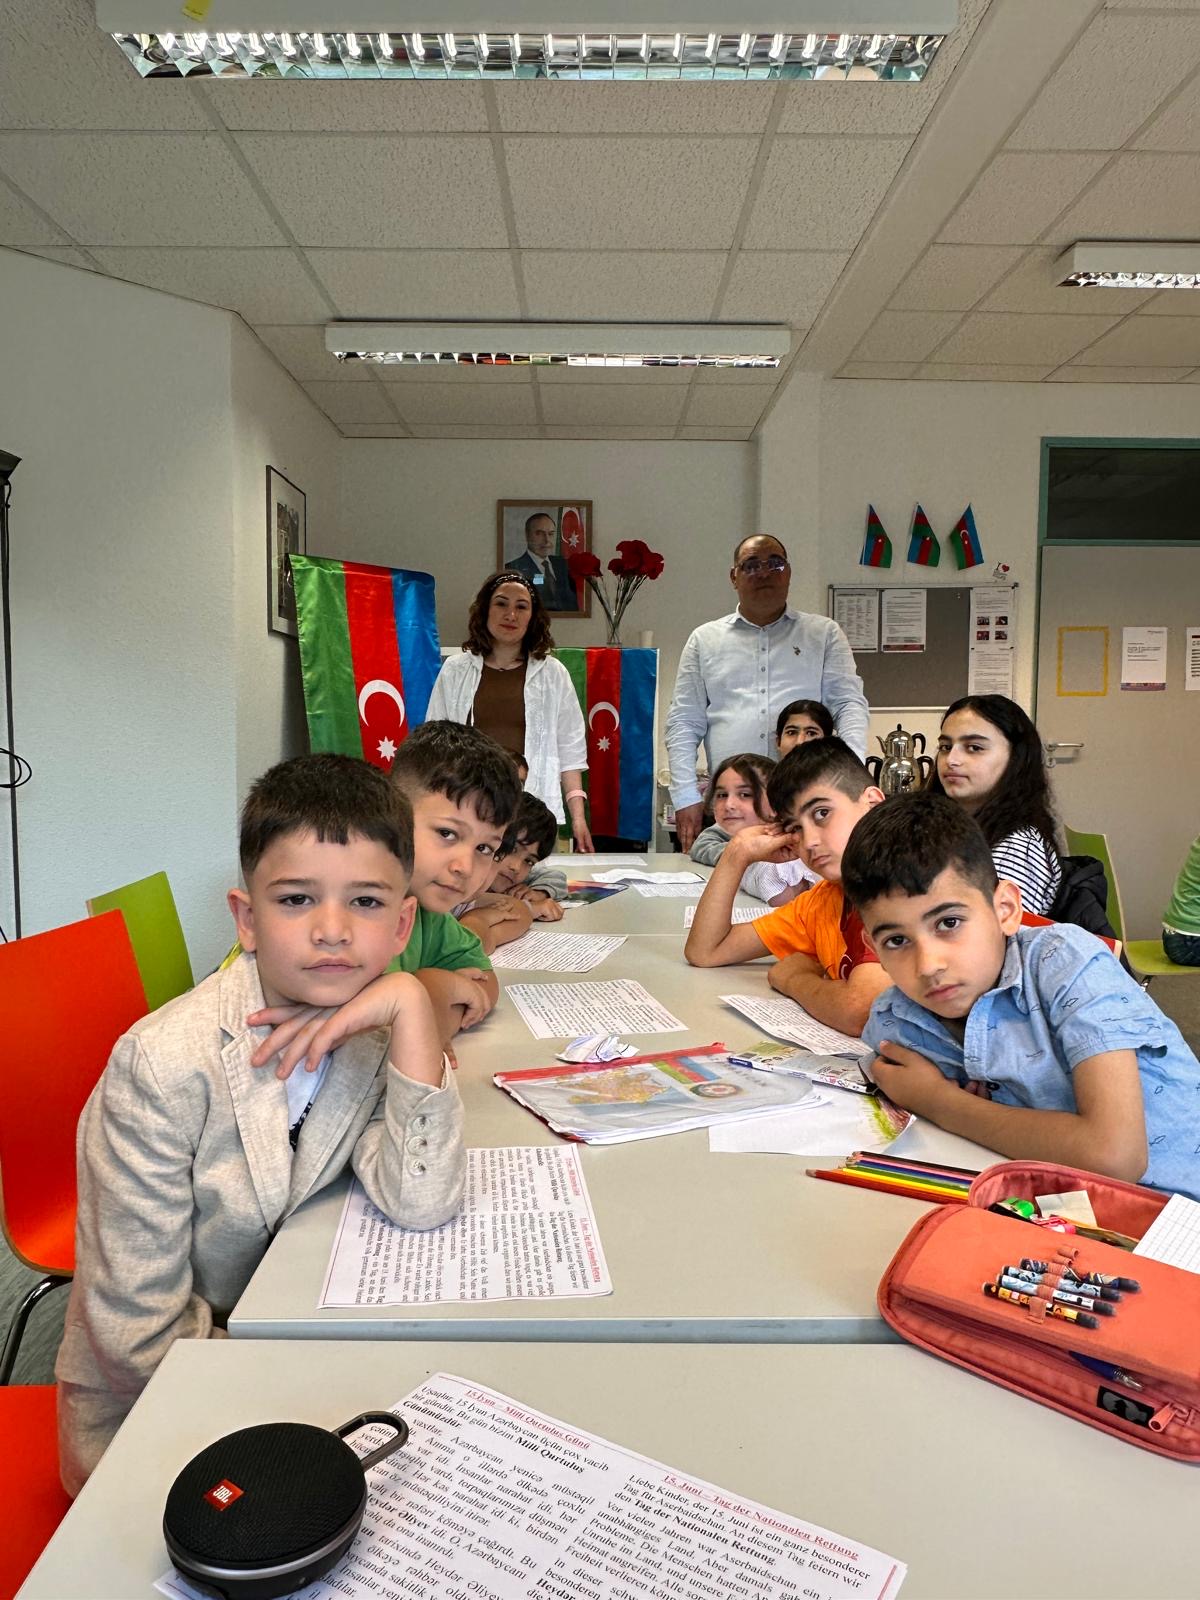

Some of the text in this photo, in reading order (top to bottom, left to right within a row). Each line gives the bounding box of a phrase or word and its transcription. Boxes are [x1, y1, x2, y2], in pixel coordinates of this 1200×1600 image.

[456, 1398, 468, 1406] 15
[488, 1414, 539, 1440] Azərbaycan
[584, 1457, 609, 1471] vacib
[456, 1410, 470, 1420] Bu
[515, 1437, 540, 1452] Milli
[540, 1449, 584, 1473] Qurtuluş
[213, 1485, 233, 1503] JBL
[450, 1436, 503, 1464] Azərbaycan
[509, 1465, 543, 1482] yenicə
[552, 1484, 595, 1505] müstəqil
[496, 1485, 533, 1504] narahat
[363, 1493, 398, 1513] eydər
[398, 1510, 430, 1529] Əliyev
[383, 1519, 396, 1528] da
[526, 1524, 558, 1545] birdən
[614, 1492, 776, 1566] den Tag der Nationalen Rettung.
[623, 1483, 639, 1496] Tag
[641, 1491, 655, 1501] für
[729, 1529, 745, 1539] An
[747, 1536, 783, 1555] diesem
[787, 1551, 805, 1566] Tag
[808, 1561, 839, 1579] feiern
[843, 1576, 861, 1588] wir
[629, 1475, 870, 1579] Liebe Kinder, der 15. Juni ist ein ganz besonderer
[678, 1483, 703, 1496] Juni
[753, 1512, 811, 1540] Nationalen
[812, 1536, 859, 1561] Rettung
[436, 1514, 476, 1537] köməyə
[520, 1555, 537, 1569] Bu
[565, 1545, 603, 1568] Freiheit
[605, 1565, 648, 1590] verlieren
[573, 1536, 609, 1558] Heimat
[661, 1579, 684, 1593] Alle
[582, 1527, 617, 1548] Unruhe
[619, 1544, 633, 1555] im
[667, 1568, 688, 1581] und
[689, 1578, 723, 1597] unsere
[590, 1518, 748, 1596] Probleme. Die Menschen hatten
[597, 1511, 661, 1543] unabhängiges
[702, 1558, 729, 1573] Aber
[735, 1572, 773, 1592] damals
[608, 1501, 820, 1600] Vor vielen Jahren war Aserbaidschan ein
[389, 1575, 426, 1598] sakitlik
[405, 1566, 440, 1587] rəhbər
[425, 1558, 463, 1582] Heydər
[545, 1568, 601, 1600] besonderen
[572, 1568, 604, 1586] dieser
